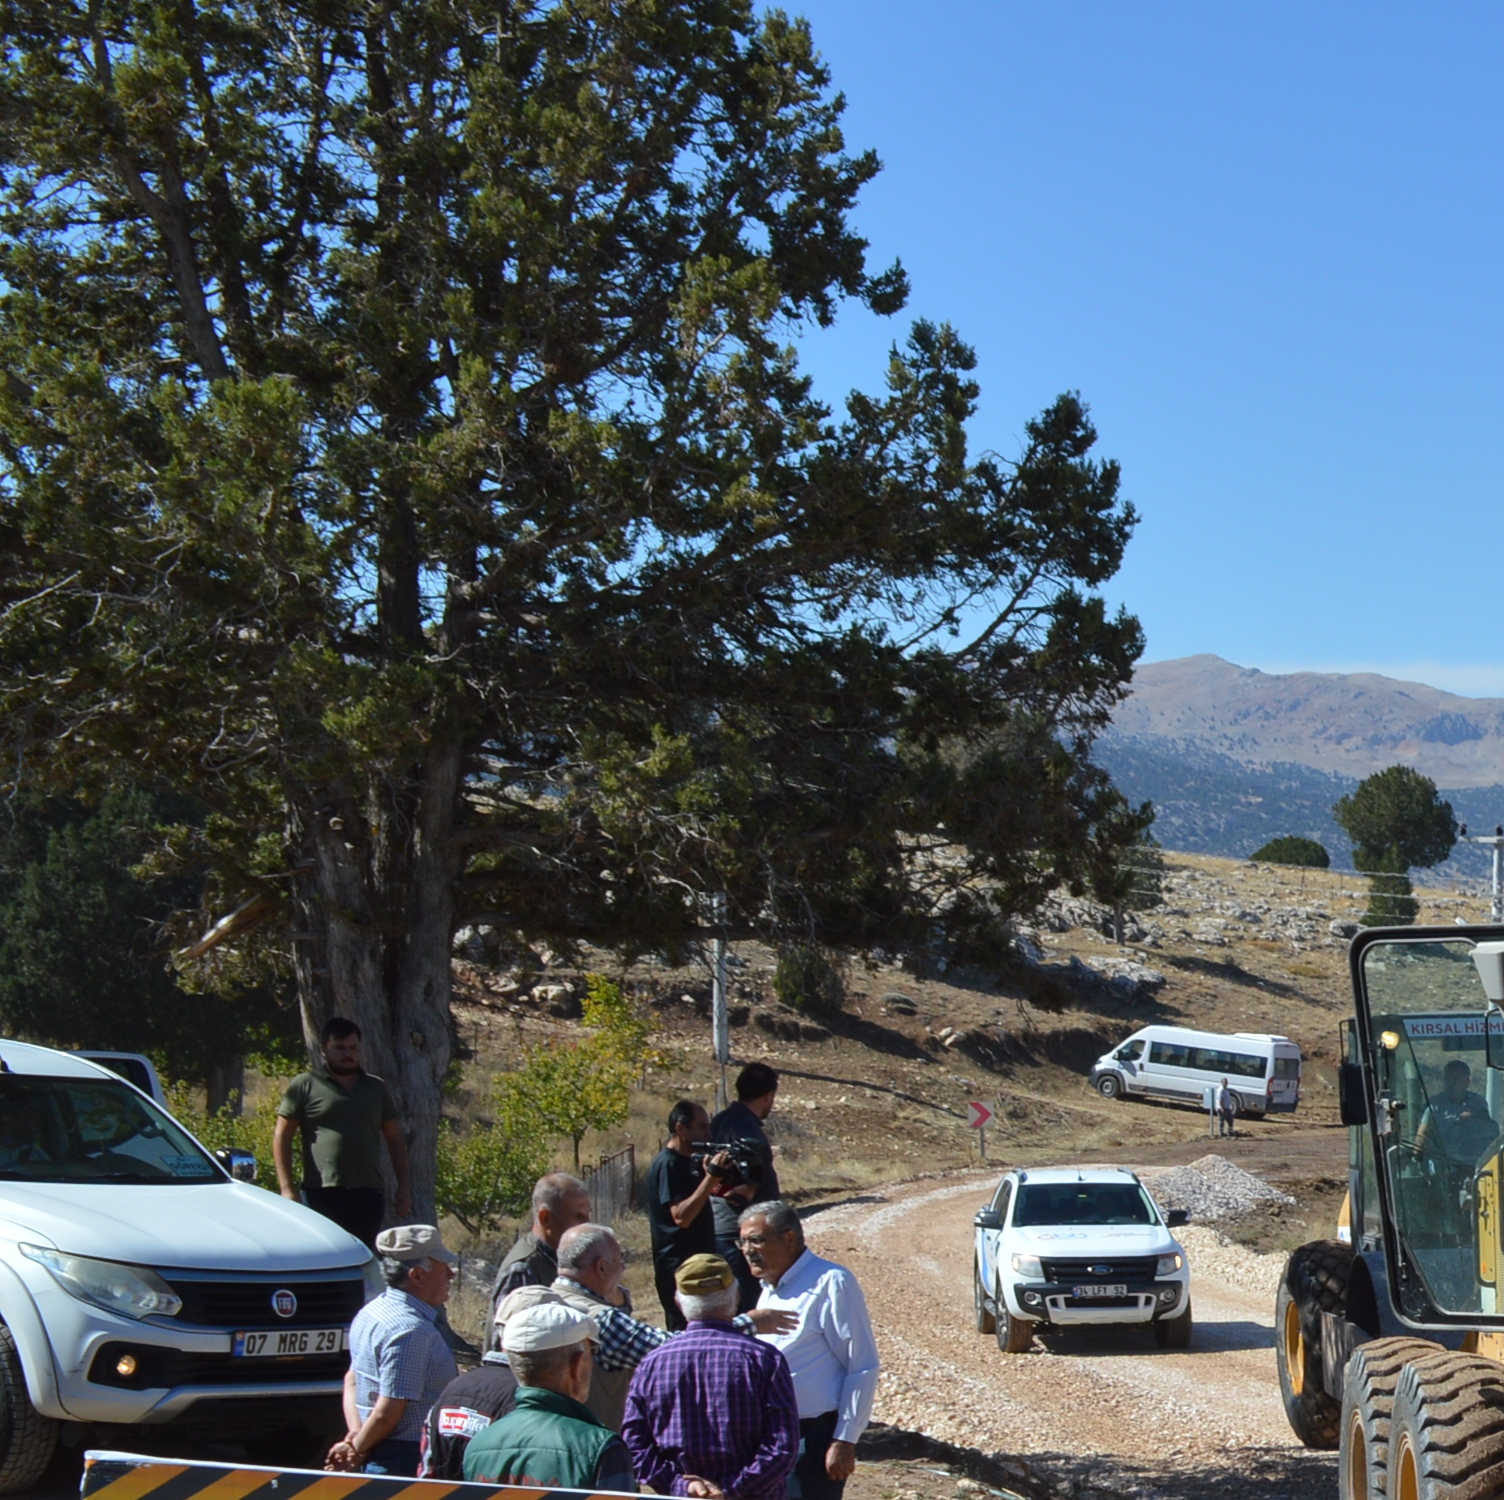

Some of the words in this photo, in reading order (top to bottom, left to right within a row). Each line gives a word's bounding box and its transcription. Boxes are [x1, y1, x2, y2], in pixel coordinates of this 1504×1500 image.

[1411, 1022, 1462, 1035] KIRSAL
[245, 1334, 268, 1355] 07
[277, 1332, 309, 1353] MRG
[316, 1331, 336, 1352] 29
